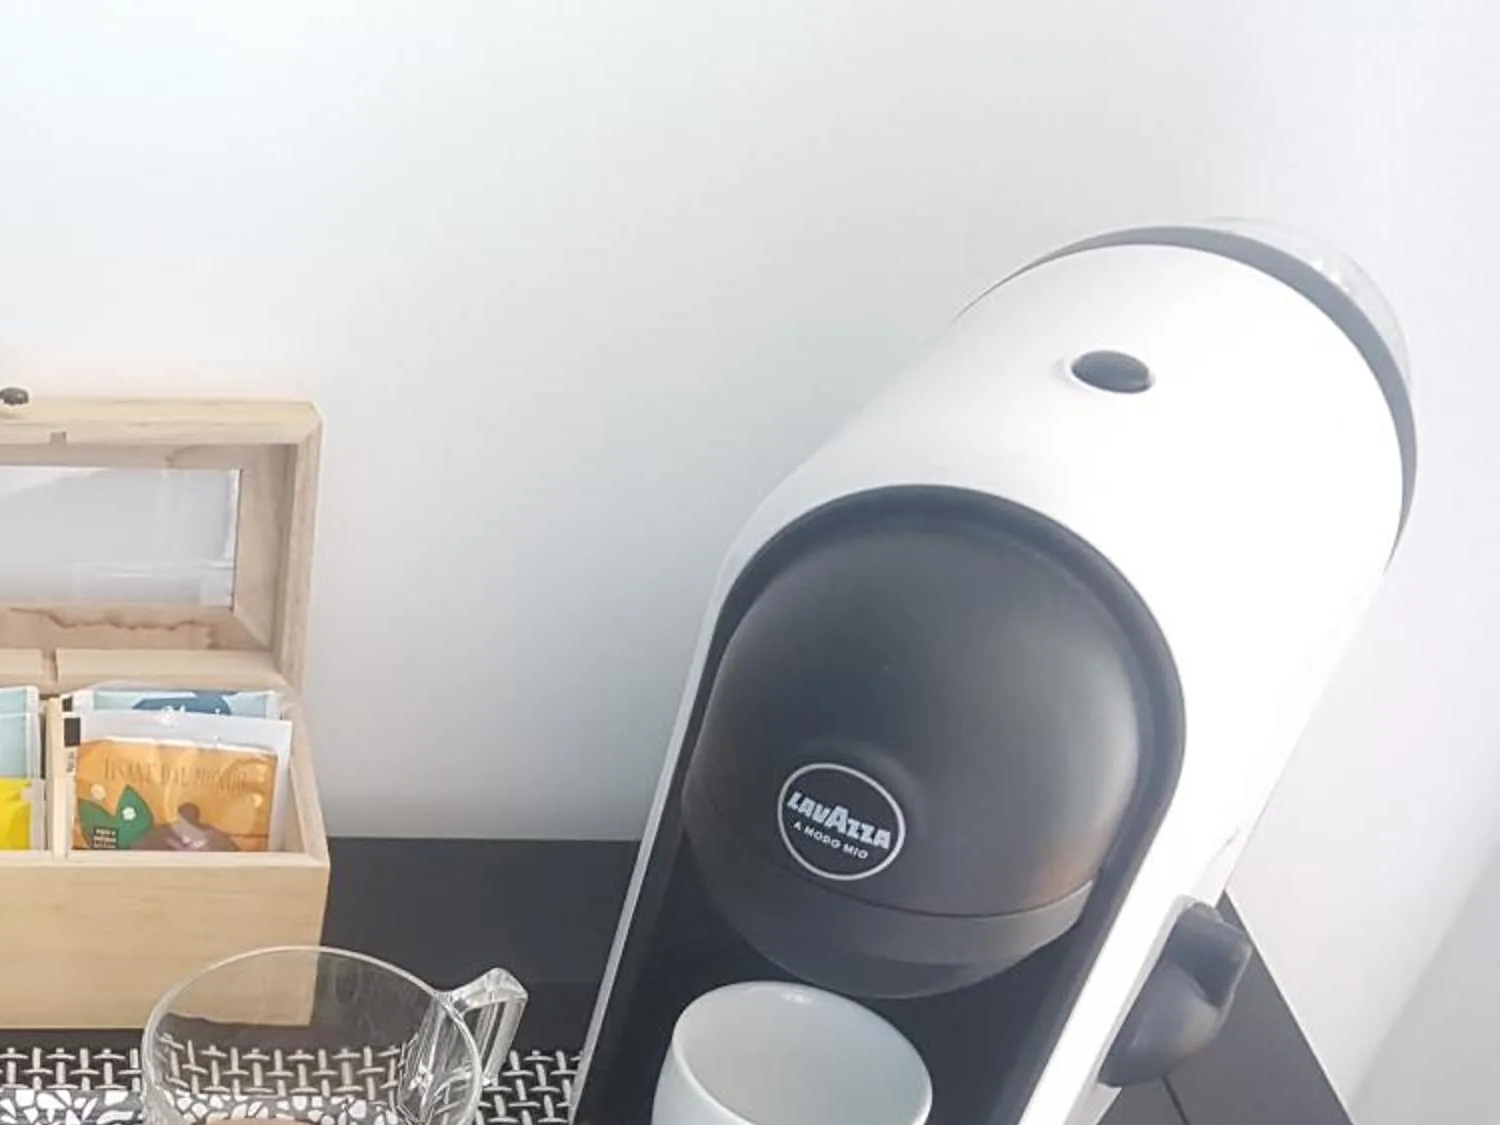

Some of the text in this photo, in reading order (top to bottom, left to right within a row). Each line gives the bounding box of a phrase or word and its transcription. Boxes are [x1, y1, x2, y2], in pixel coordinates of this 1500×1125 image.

[786, 791, 891, 850] LAVAZZA
[793, 820, 869, 860] A MODO MIO
